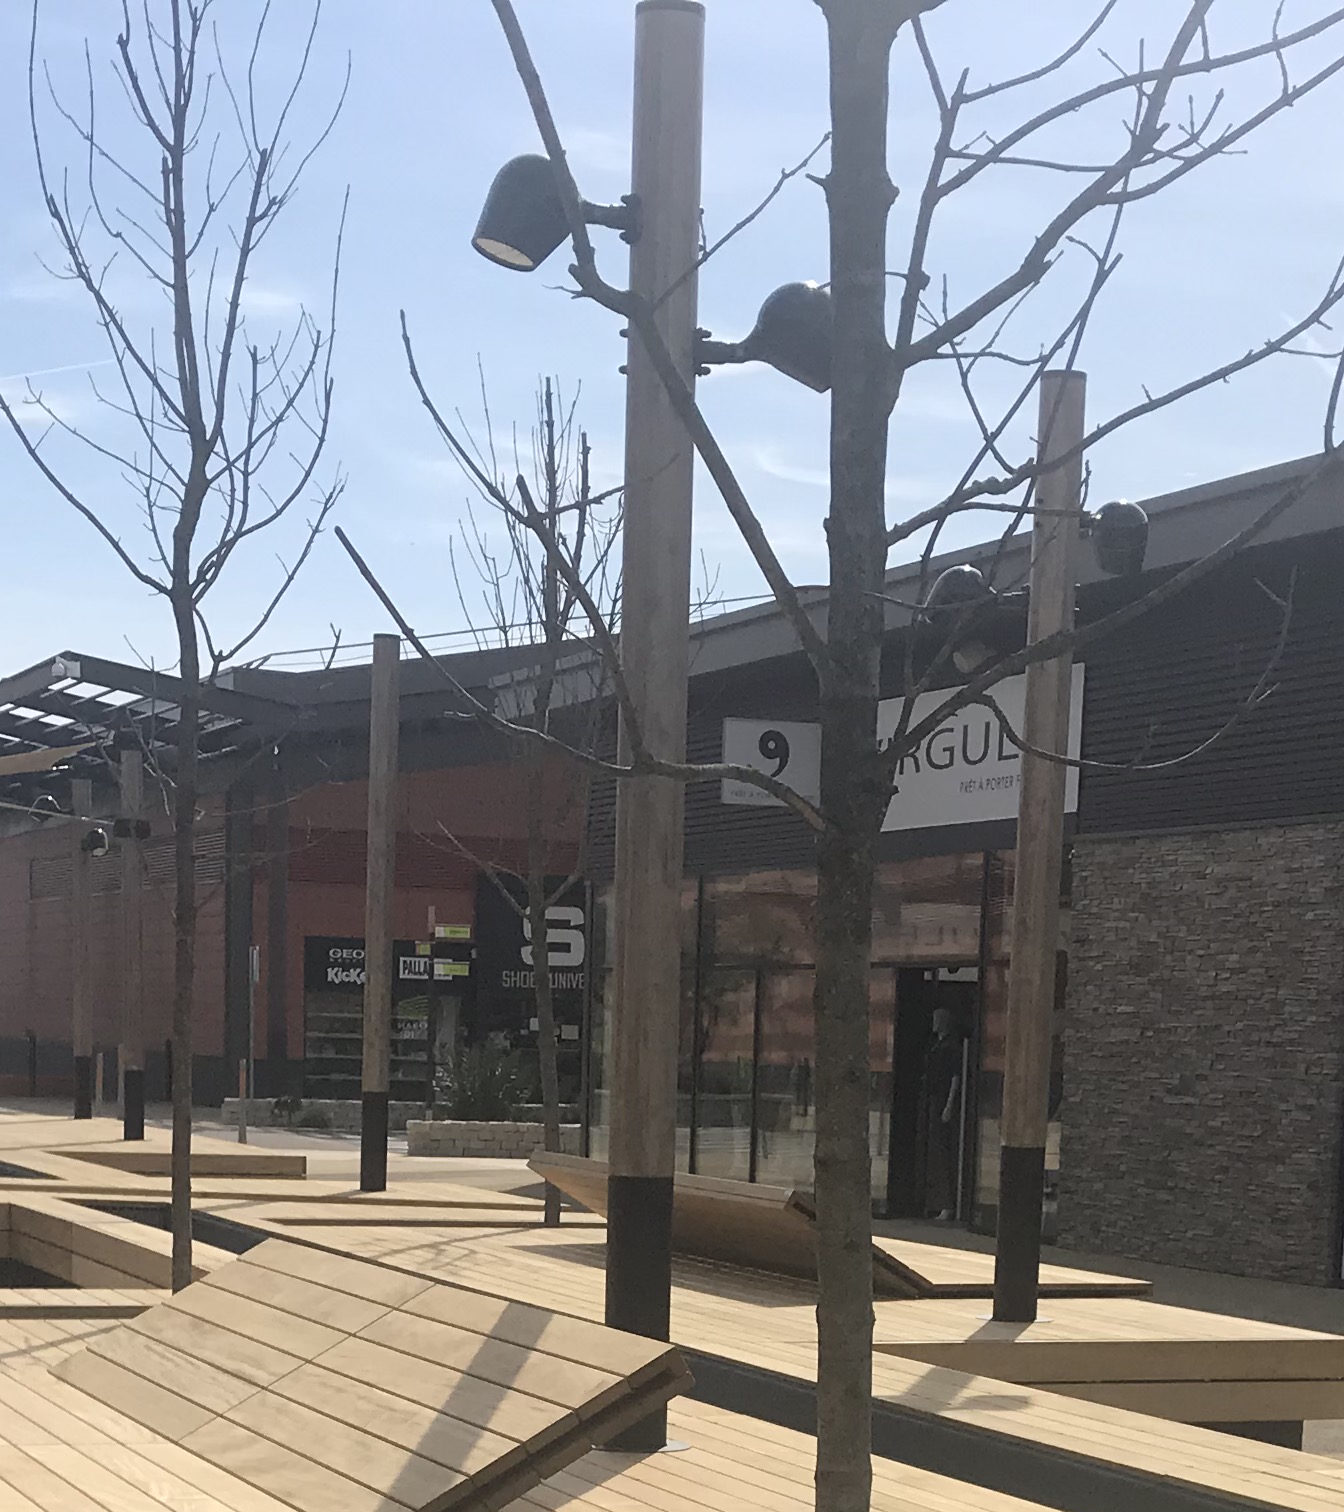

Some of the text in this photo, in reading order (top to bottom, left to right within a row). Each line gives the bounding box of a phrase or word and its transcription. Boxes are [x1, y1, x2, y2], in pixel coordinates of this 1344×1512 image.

[878, 721, 1020, 776] RGUL
[328, 948, 365, 960] GEO
[502, 970, 585, 990] SHOE UNIVE
